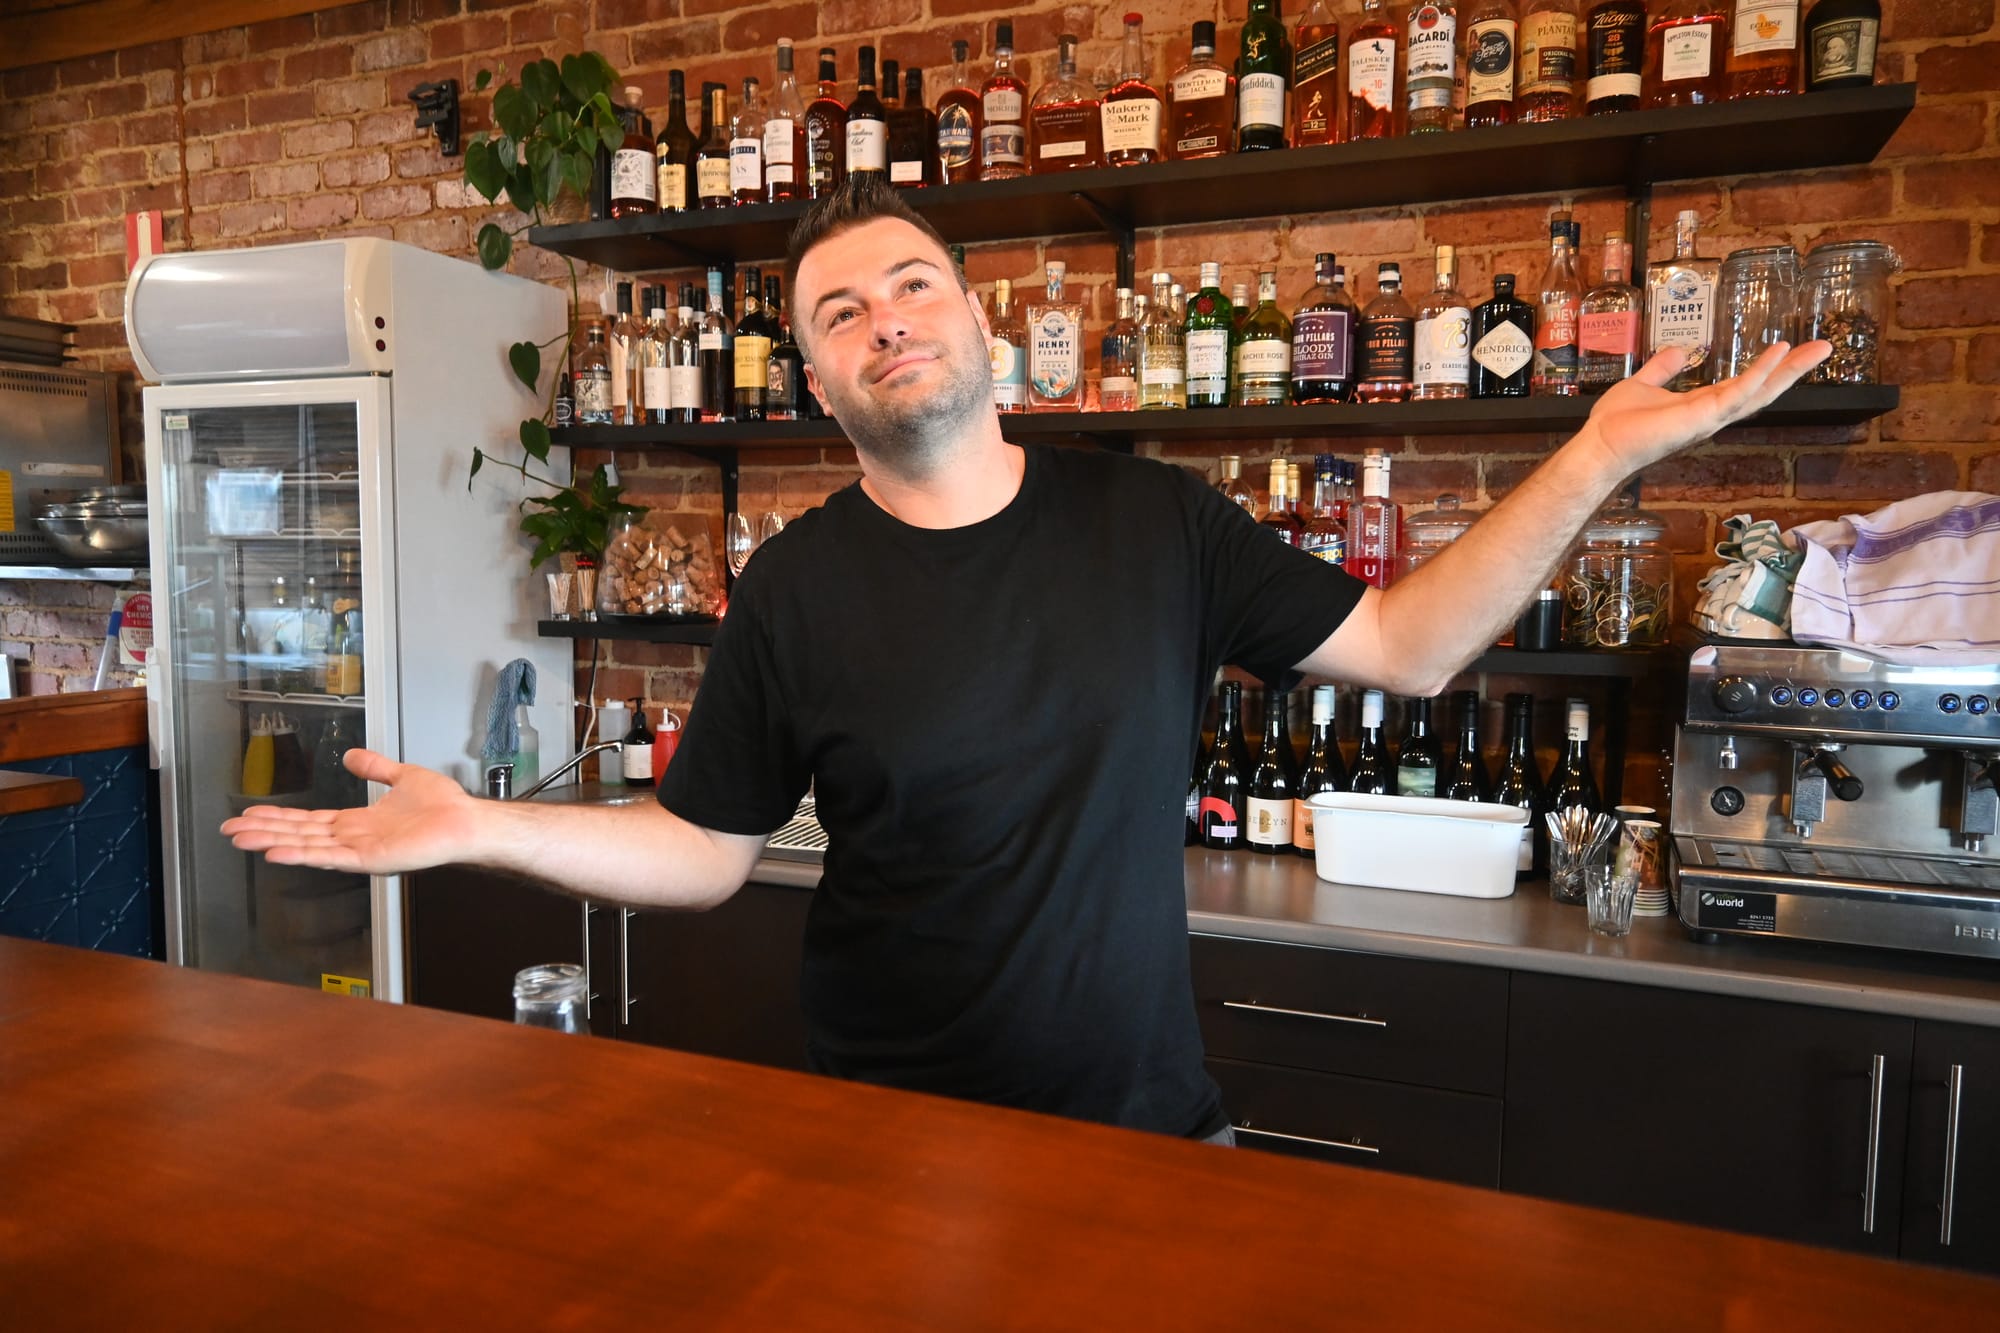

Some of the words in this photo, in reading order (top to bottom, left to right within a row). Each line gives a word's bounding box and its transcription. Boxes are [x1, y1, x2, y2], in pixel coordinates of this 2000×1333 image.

[1750, 20, 1782, 31] ECLIPSE
[1352, 56, 1390, 67] TALISKER
[1177, 78, 1222, 89] GENTLEMAN
[1190, 85, 1208, 93] JACK
[1106, 103, 1151, 115] Maker's
[1117, 114, 1150, 123] Mark
[1661, 303, 1704, 314] HENRY
[1305, 332, 1335, 342] PILLARS
[1038, 340, 1070, 349] HENRY
[1293, 343, 1334, 355] BLOODY
[126, 611, 152, 619] CHEMIC
[1716, 899, 1744, 908] world
